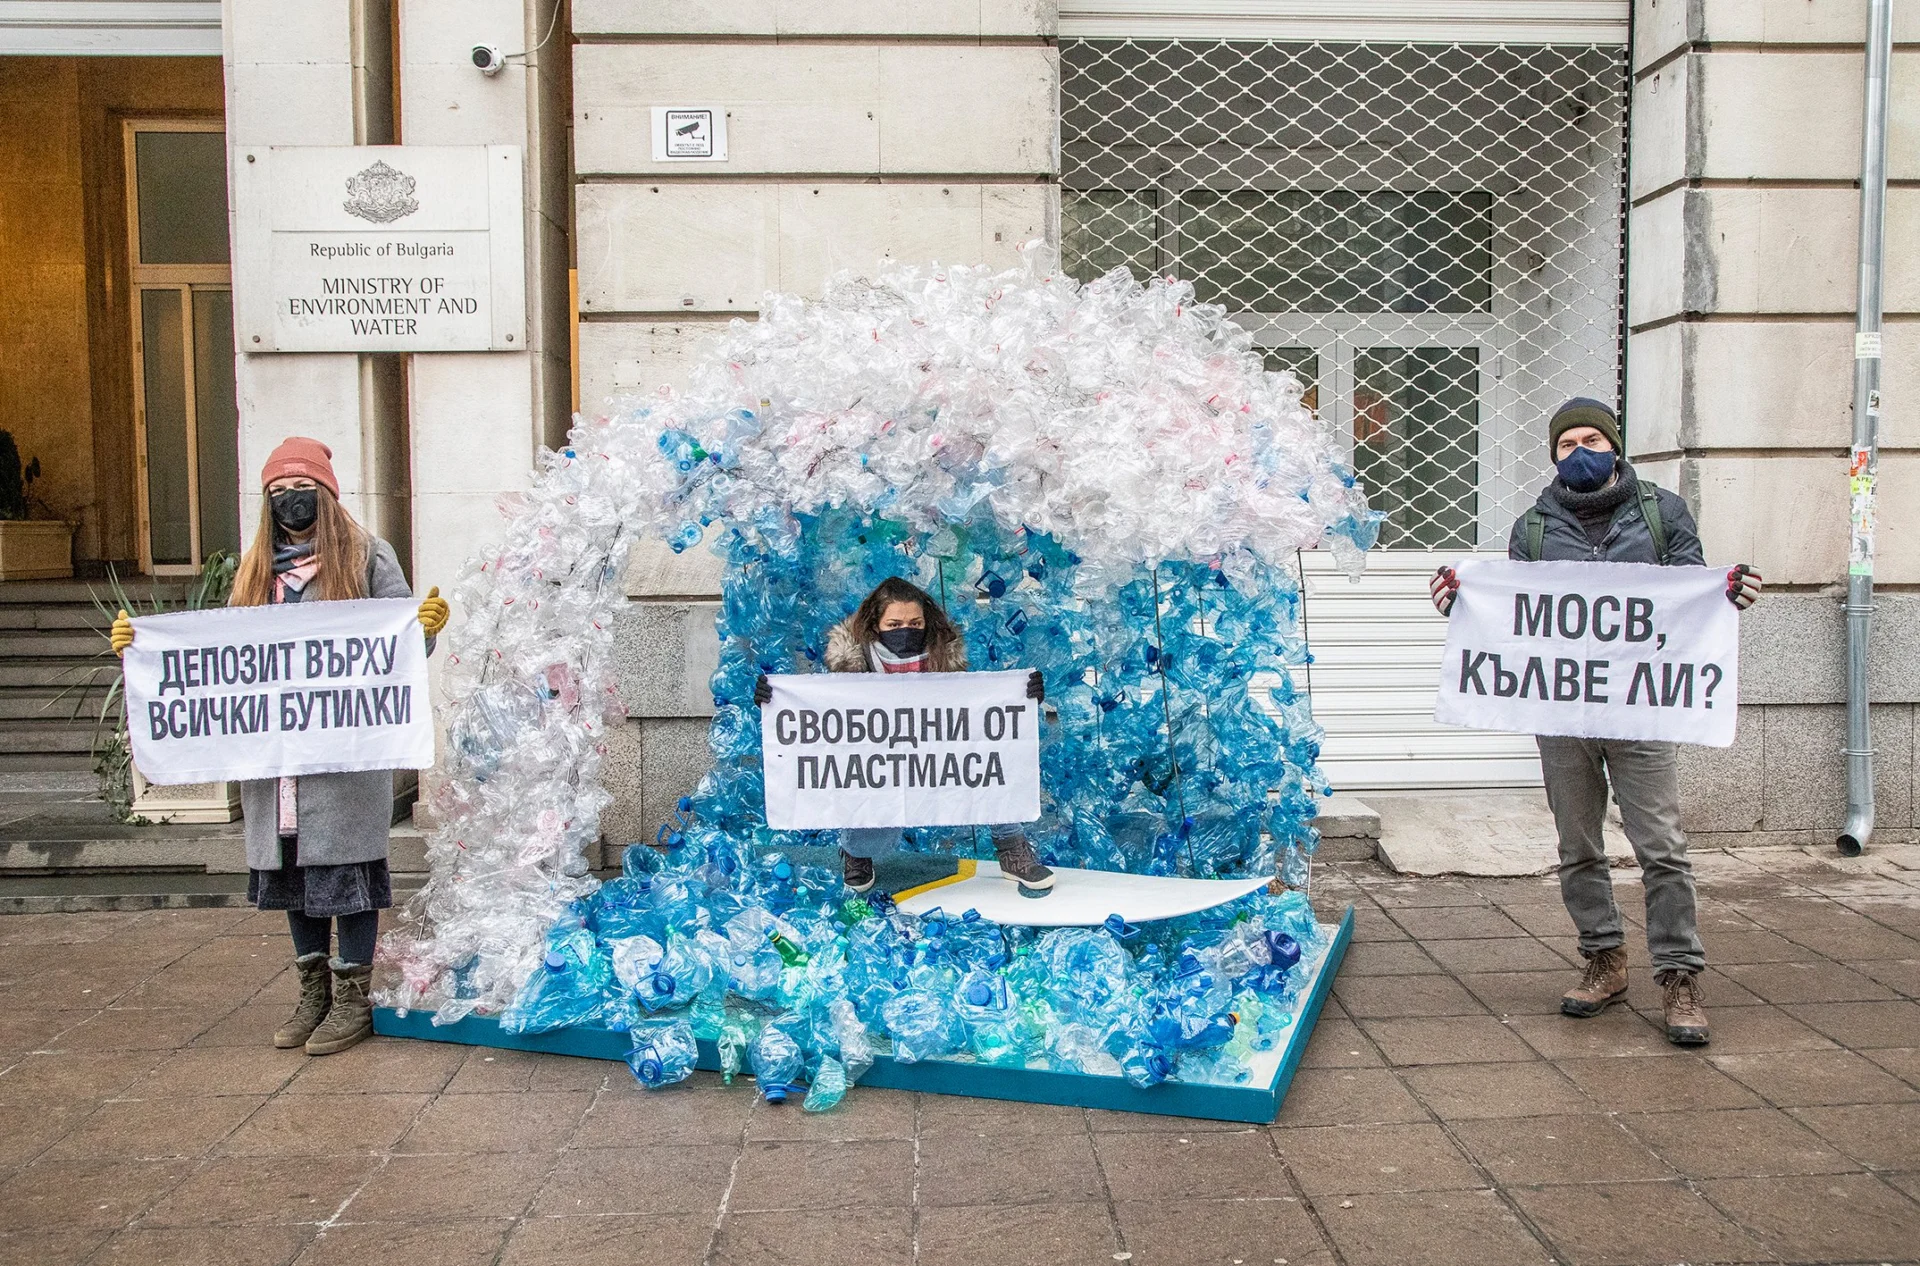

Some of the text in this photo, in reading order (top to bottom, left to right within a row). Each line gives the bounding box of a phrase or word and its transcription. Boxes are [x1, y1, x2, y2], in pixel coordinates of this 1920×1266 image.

[310, 243, 455, 260] Republic of Bulgaria
[322, 277, 444, 295] MINISTRY OF
[289, 298, 478, 316] ENVIRONMENT AND
[351, 319, 418, 336] WATER
[1513, 593, 1667, 651] МОСВ,
[158, 634, 398, 697] ДЕПОЗИТ ВЪРХУ
[1459, 649, 1723, 710] КЪЛВЕ ЛИ?
[148, 685, 412, 741] ВСИЧКИ БУТИЛКИ
[775, 704, 1026, 749] СВОБОДНИ ОТ
[797, 751, 1006, 789] ПЛАСТМАСА
